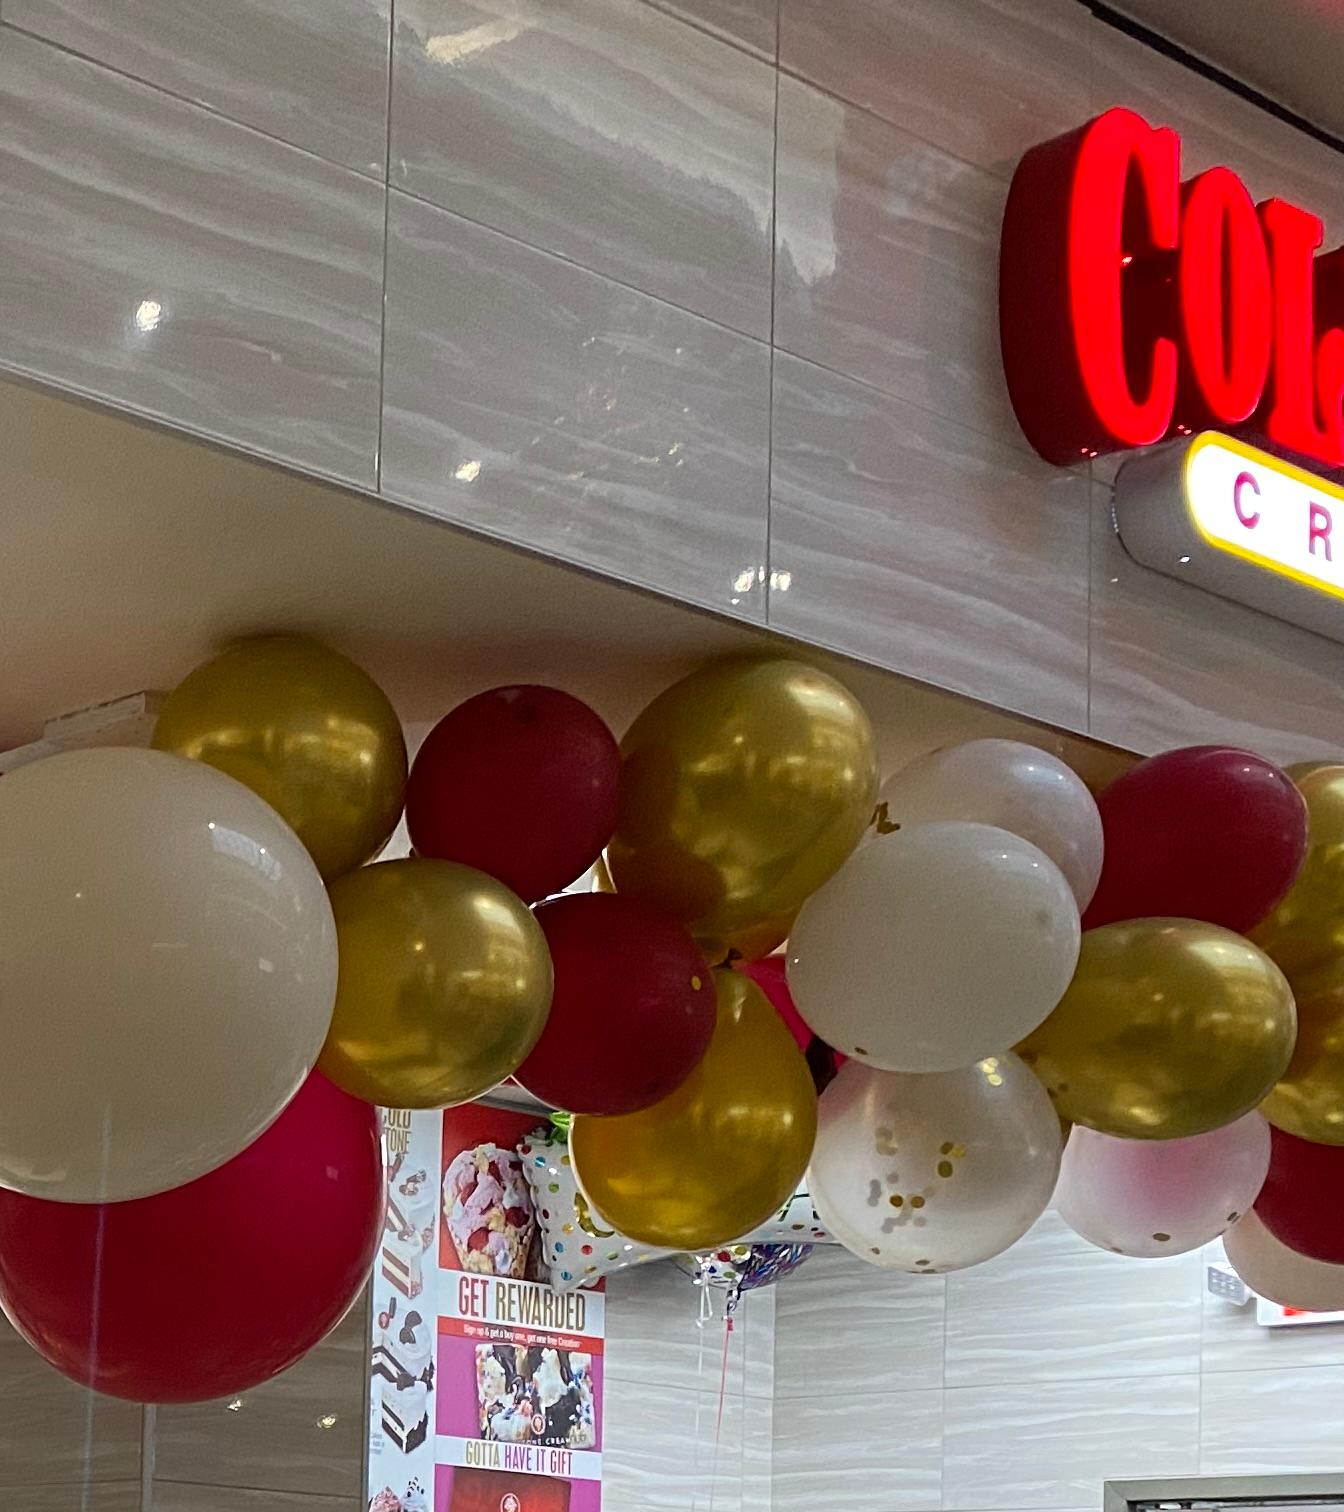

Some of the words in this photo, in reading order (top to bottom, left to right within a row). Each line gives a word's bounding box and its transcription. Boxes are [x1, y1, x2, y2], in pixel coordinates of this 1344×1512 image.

[1069, 106, 1344, 468] COL
[384, 1109, 411, 1130] OLD
[385, 1127, 412, 1154] TONE
[459, 1276, 489, 1318] GET
[496, 1281, 586, 1332] REWARDED
[465, 1440, 500, 1466] GOTTA
[504, 1445, 532, 1472] HAVE
[536, 1448, 546, 1473] IT
[550, 1450, 573, 1476] GIFT
